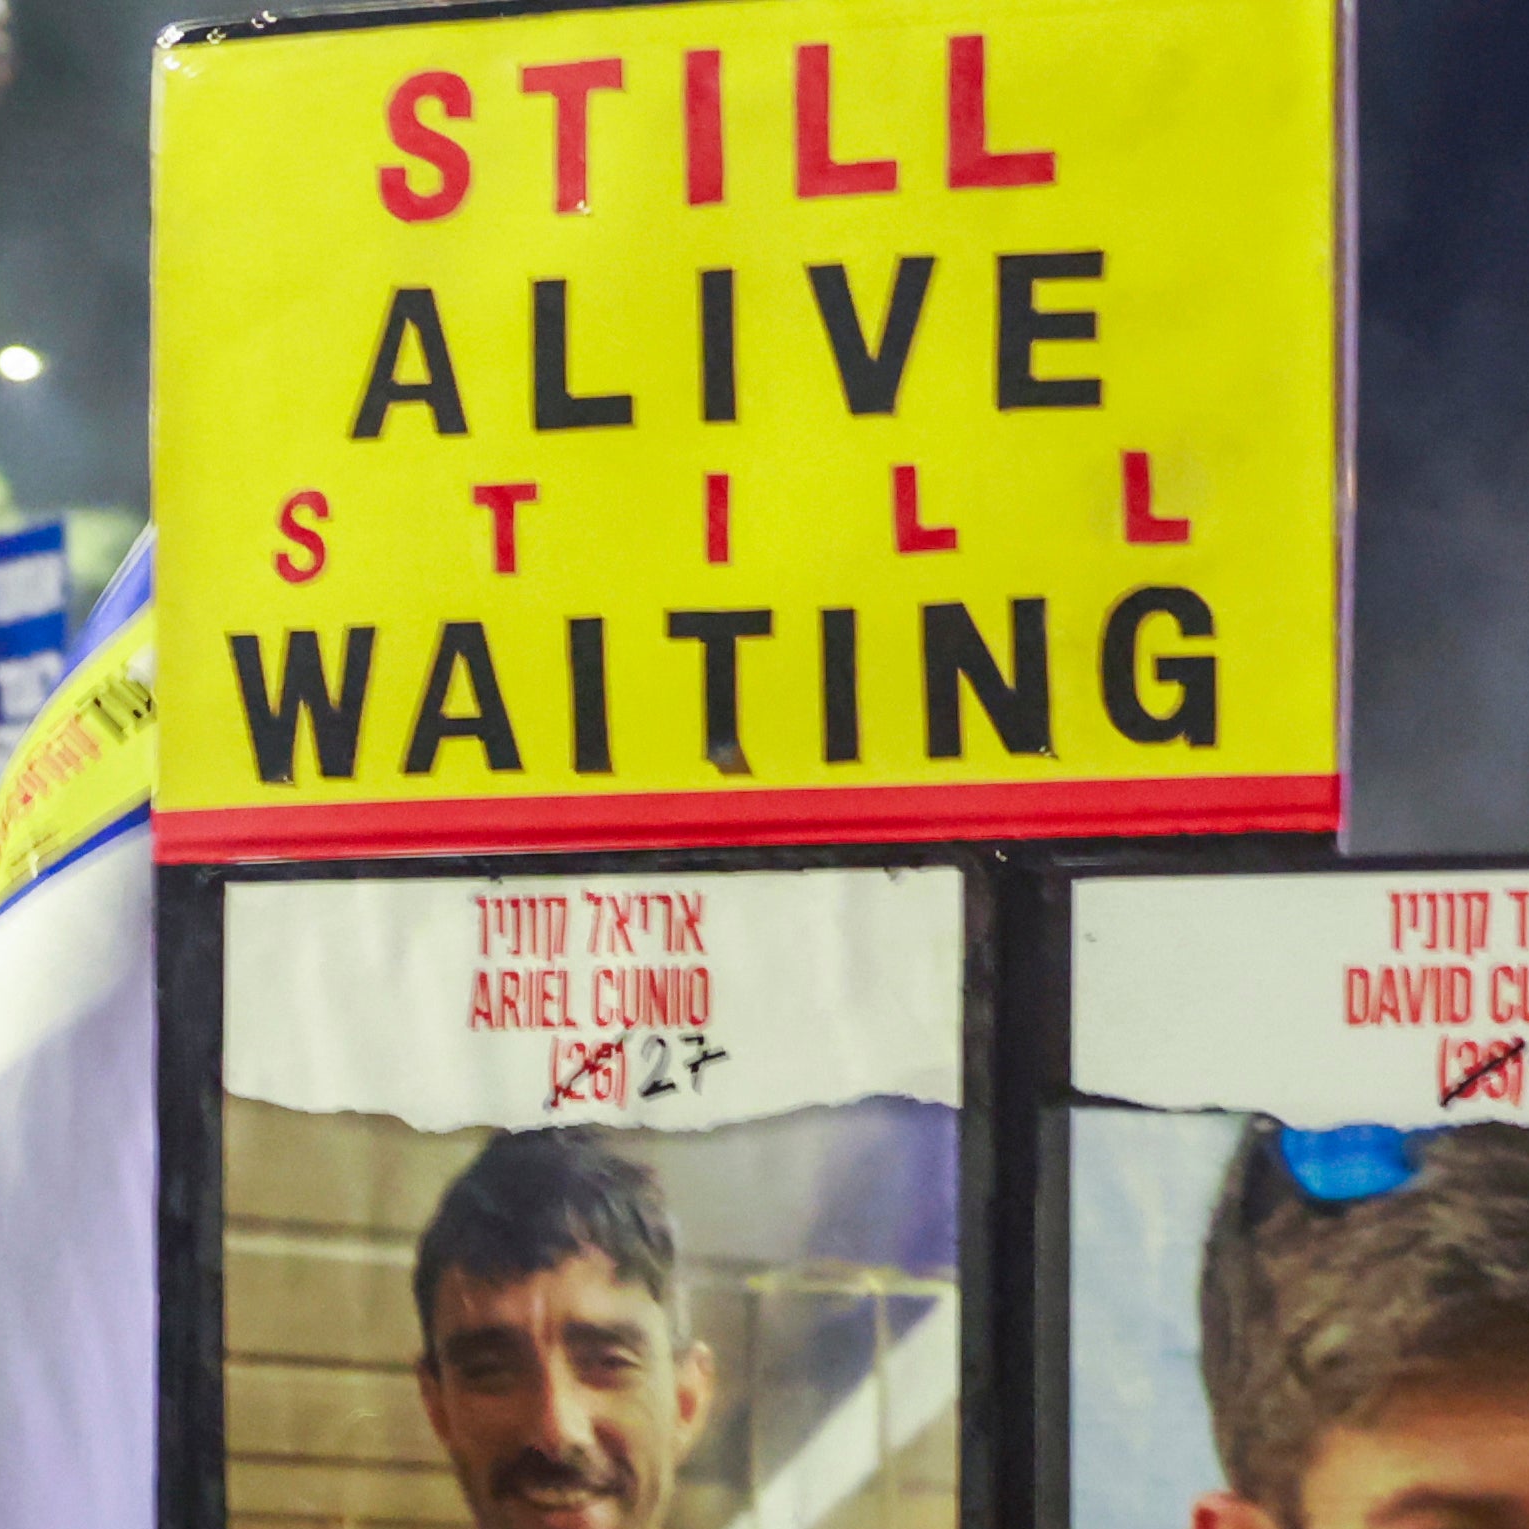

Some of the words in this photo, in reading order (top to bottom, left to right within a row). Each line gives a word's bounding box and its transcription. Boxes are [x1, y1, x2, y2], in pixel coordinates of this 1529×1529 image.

[378, 33, 1057, 224] STILL
[350, 249, 1106, 440] ALIVE
[274, 449, 1192, 585] STILL
[227, 584, 1219, 787] WAITING
[474, 894, 570, 962] קוניו
[583, 889, 706, 954] אריאל
[1387, 889, 1492, 959] קוניו
[469, 967, 580, 1030] ARIEL
[592, 965, 711, 1030] CUNIO
[1344, 964, 1474, 1027] DAVID
[639, 1034, 728, 1099] 27
